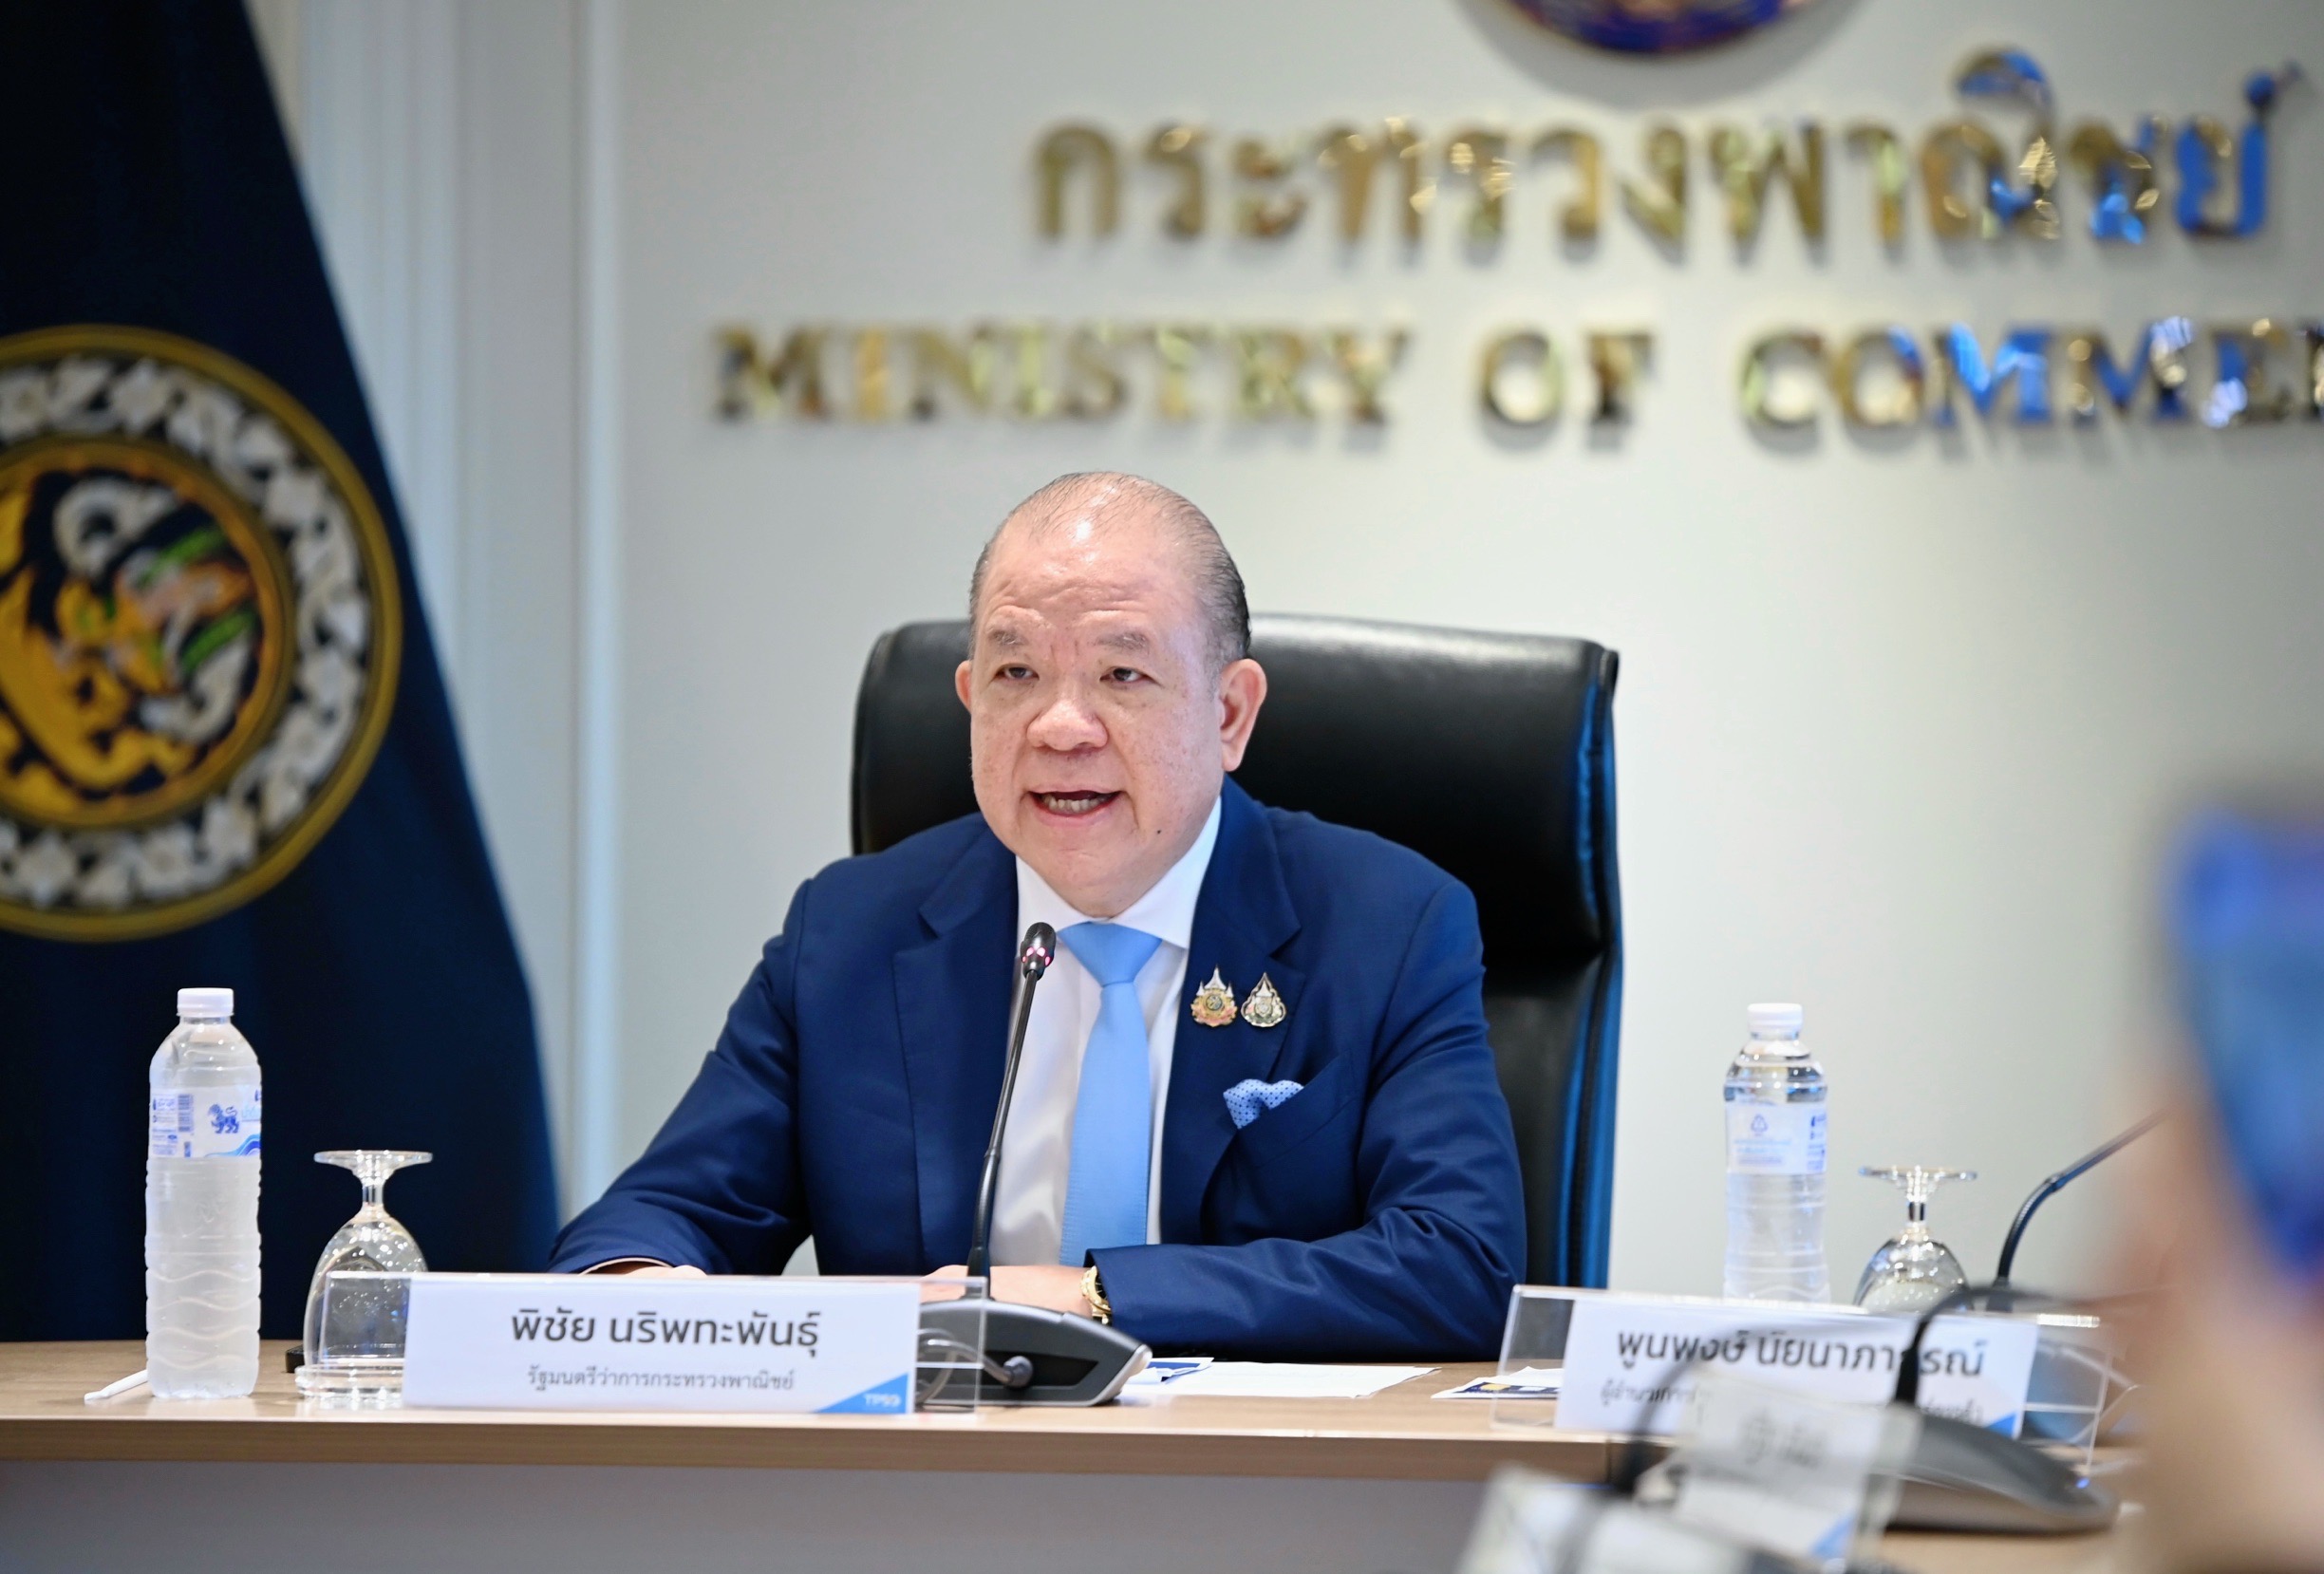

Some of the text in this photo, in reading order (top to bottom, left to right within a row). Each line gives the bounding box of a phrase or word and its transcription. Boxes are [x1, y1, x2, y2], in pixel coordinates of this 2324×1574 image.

[1033, 46, 2303, 247] กระทรวงพาณิชย์
[714, 321, 2324, 427] MINISTRY OF COMME
[511, 1305, 822, 1358] พิชัย นริพทะพันธุ์
[1756, 1329, 1988, 1377] นัยนาภารณ์
